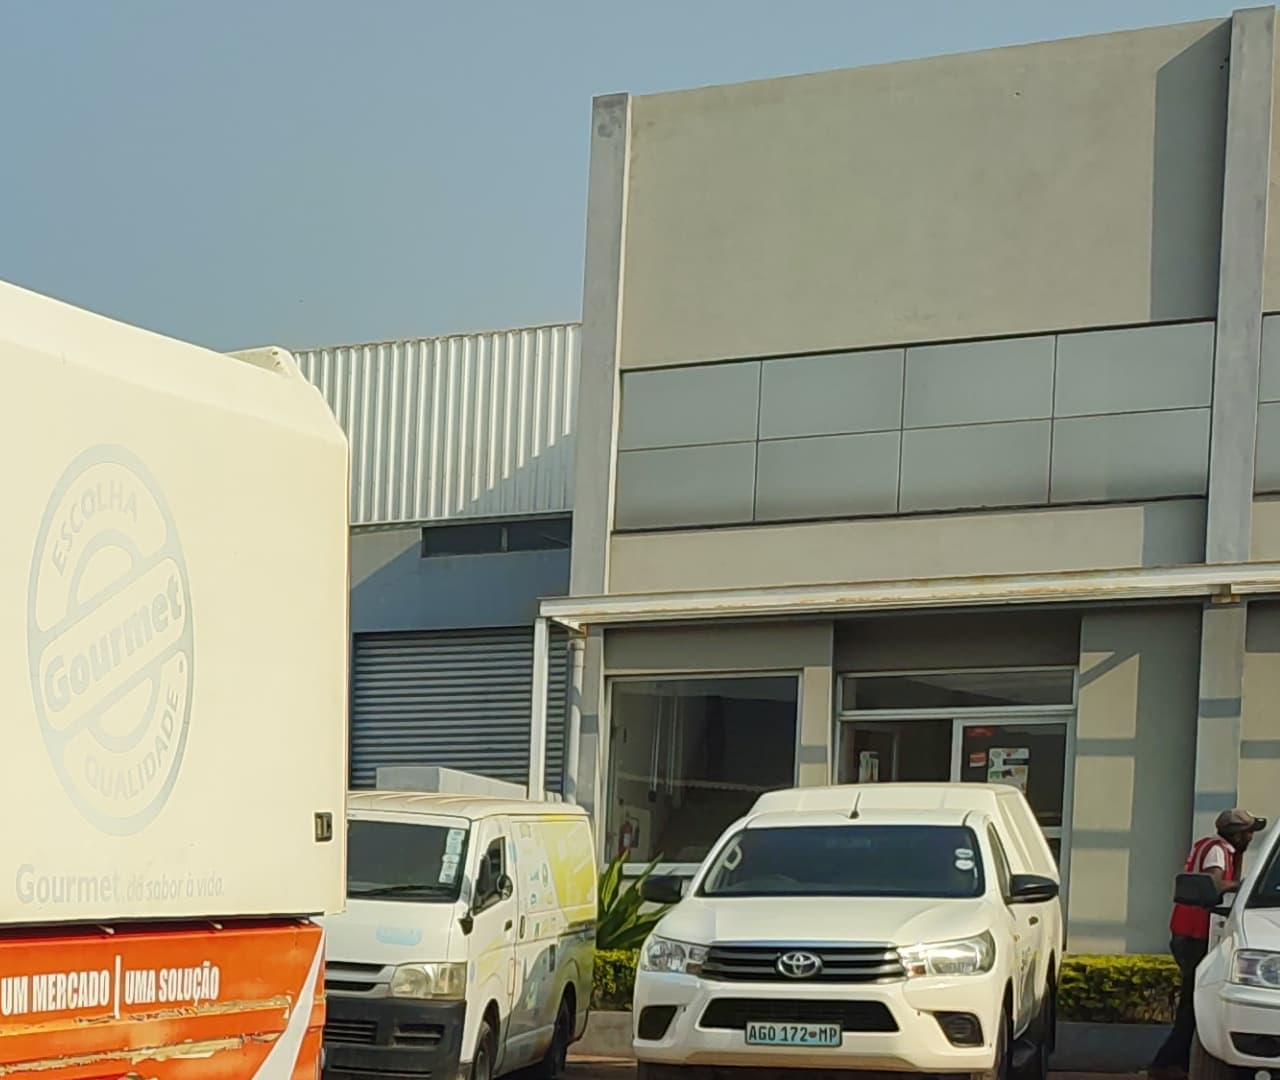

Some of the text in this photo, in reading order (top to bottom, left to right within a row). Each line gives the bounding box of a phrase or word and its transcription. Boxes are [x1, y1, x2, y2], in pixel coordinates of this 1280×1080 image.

[51, 480, 139, 576] ESCOLHA
[43, 573, 182, 714] Gourmet
[83, 687, 179, 801] QUALIDADE
[0, 975, 29, 1016] UM
[31, 969, 111, 1014] MERCADO
[124, 967, 156, 1006] UMA
[158, 960, 220, 1006] SOLUÇÃO
[779, 1026, 809, 1042] 172
[818, 1027, 838, 1043] MP
